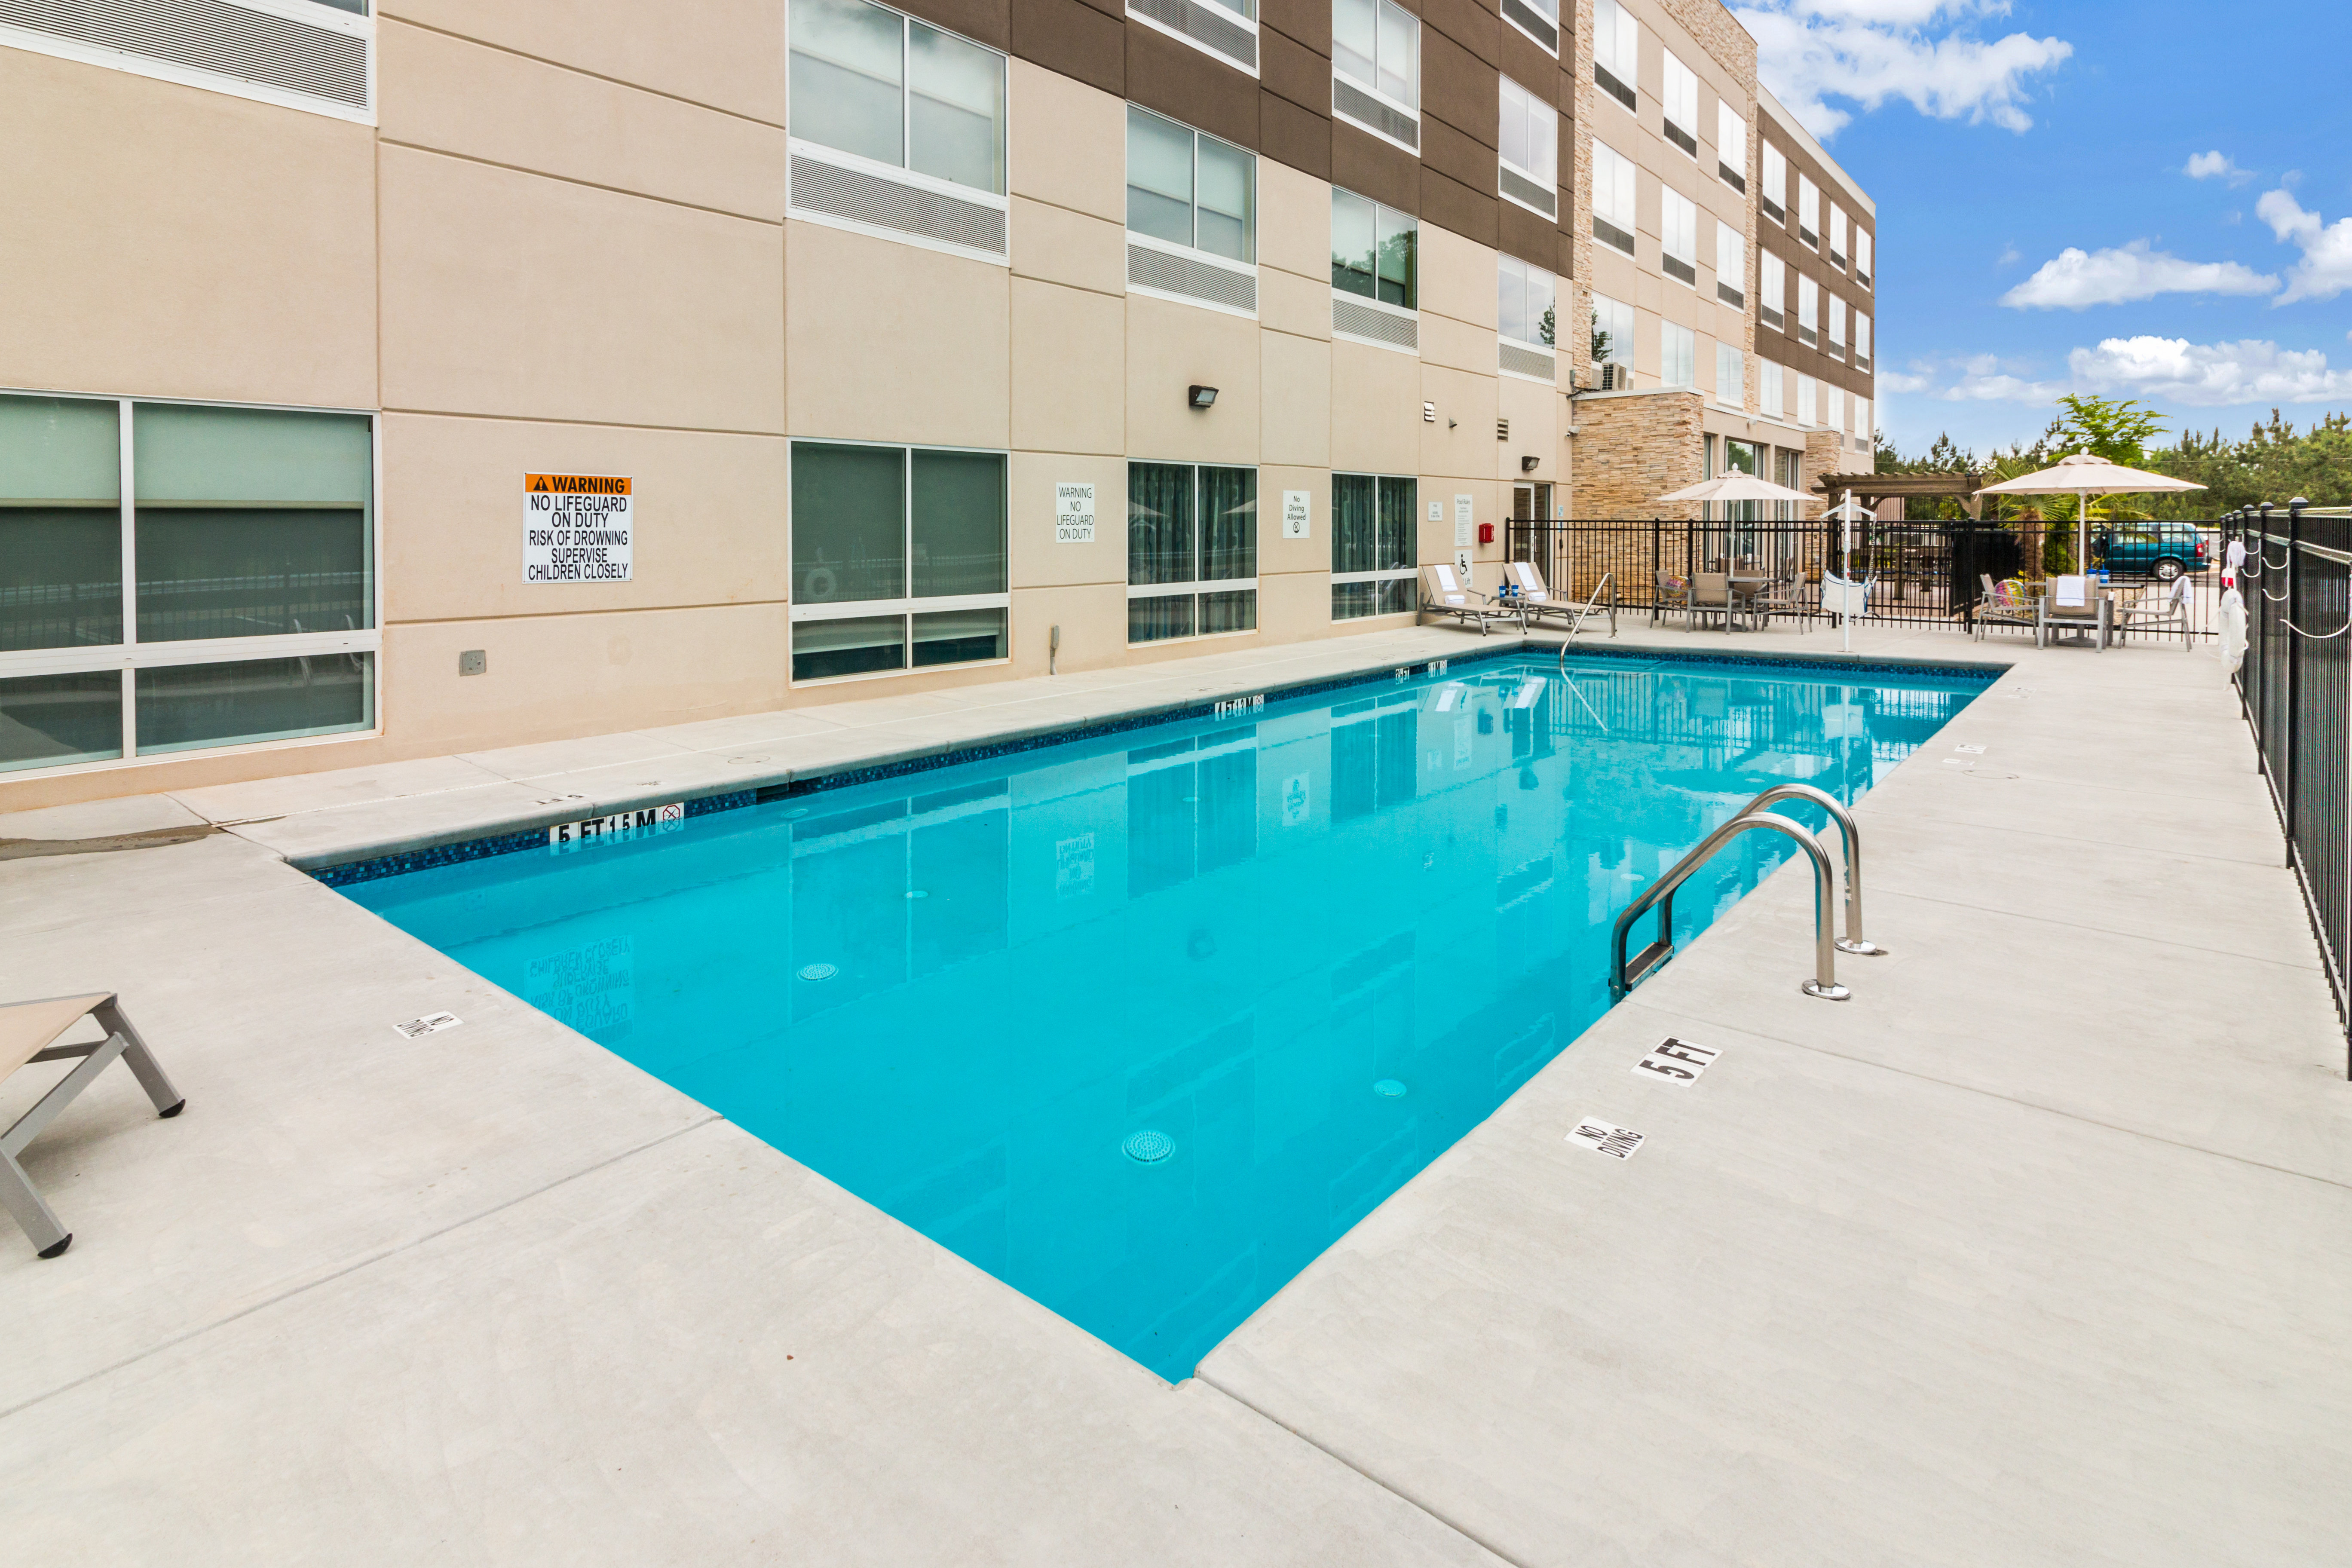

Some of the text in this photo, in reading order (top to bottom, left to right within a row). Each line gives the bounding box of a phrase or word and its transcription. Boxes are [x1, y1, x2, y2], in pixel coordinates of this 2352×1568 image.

[552, 476, 625, 493] WARNING
[1059, 487, 1092, 498] WARNING
[531, 495, 627, 512] NO LIFEGUARD
[1070, 501, 1081, 511] NO
[1289, 505, 1304, 513] Diving
[551, 511, 609, 528] ON DUTY
[1057, 514, 1094, 525] LIFEGUARD
[530, 530, 628, 546] RISK OF DROWNING
[1060, 528, 1091, 539] ON DUTY
[551, 548, 607, 564] SUPERVISE
[528, 563, 628, 580] CHILDREN CLOSELY
[559, 824, 570, 843] 5
[581, 818, 604, 839] FT
[636, 809, 655, 828] M
[396, 1019, 435, 1037] DIVING
[426, 1015, 454, 1026] NO
[1638, 1038, 1716, 1079] 5 FT
[1575, 1126, 1608, 1142] NO
[1597, 1129, 1644, 1158] DIVING
